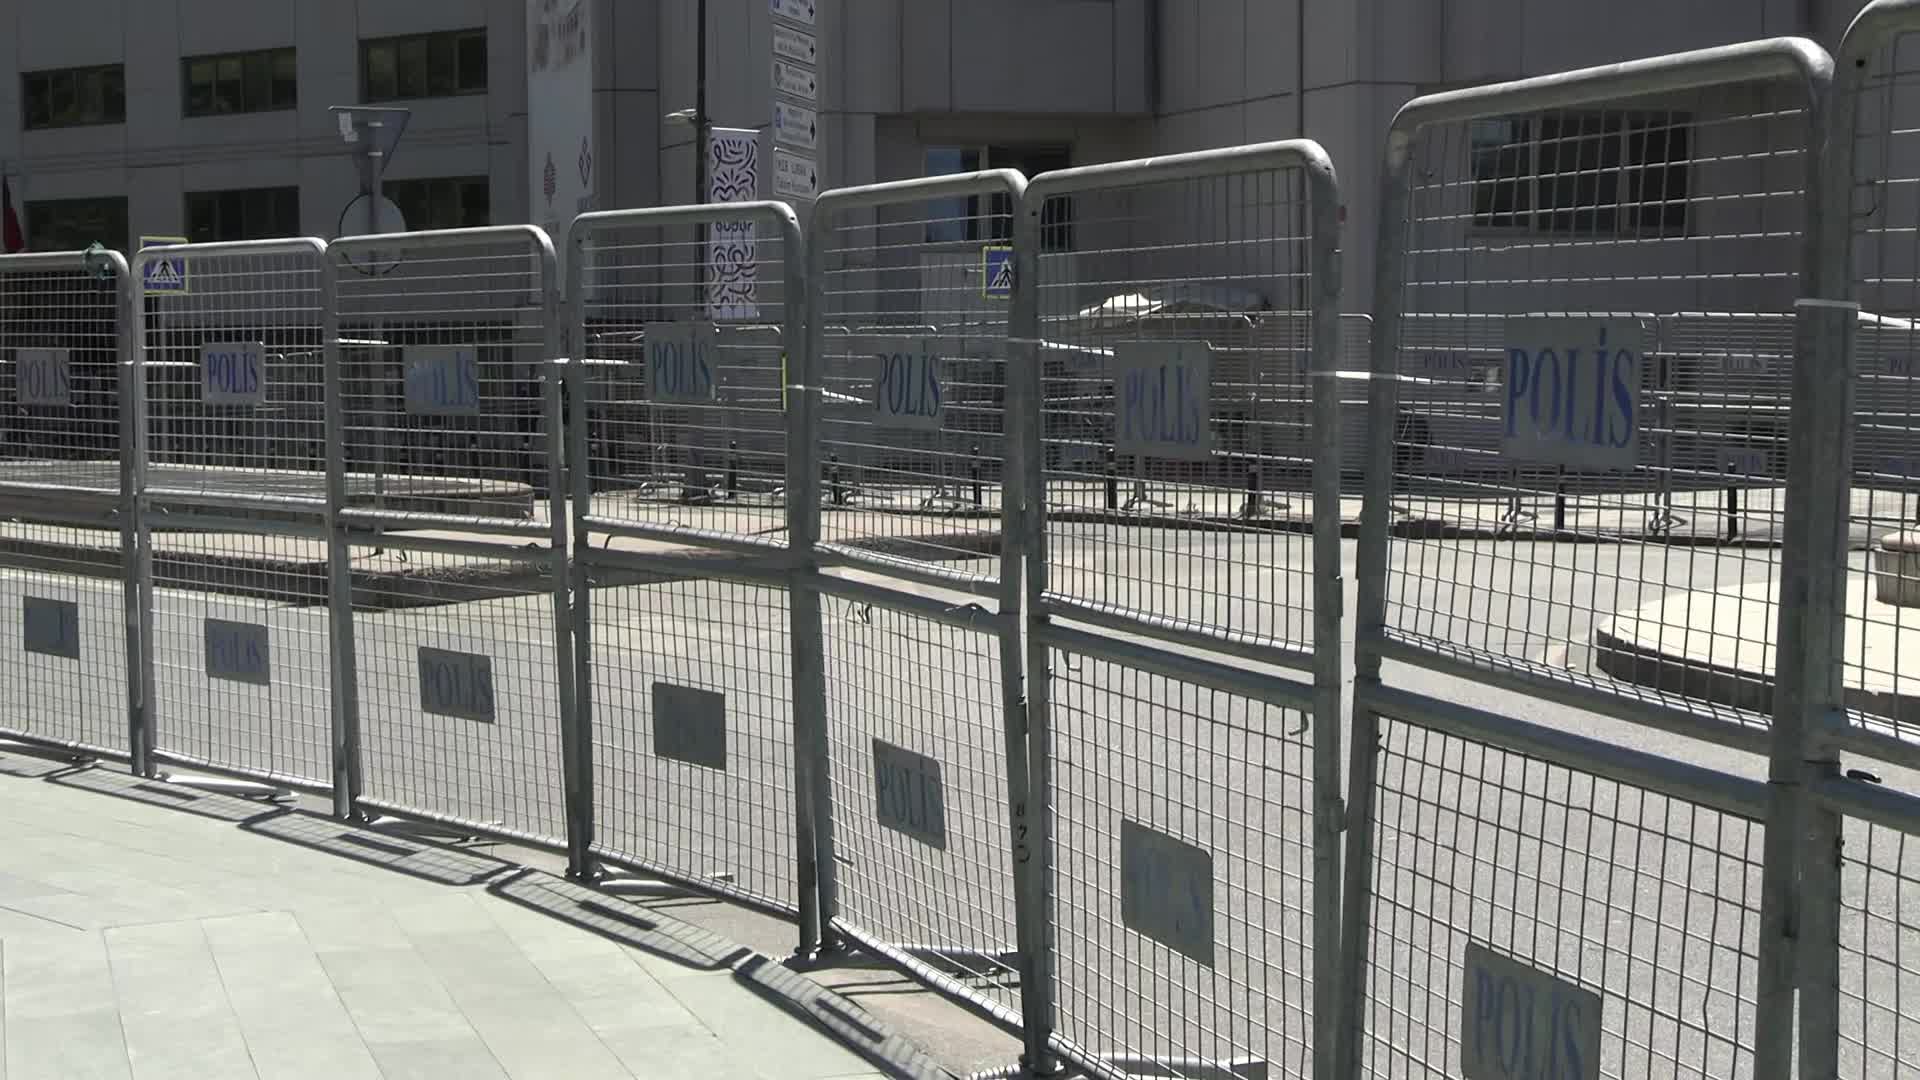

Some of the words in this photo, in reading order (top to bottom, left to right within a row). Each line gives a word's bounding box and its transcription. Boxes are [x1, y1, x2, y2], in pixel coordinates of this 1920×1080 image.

[18, 353, 70, 400] POLİS
[208, 344, 258, 393] POLİS
[409, 351, 480, 408] LİS
[652, 328, 712, 396] POLİS
[877, 338, 940, 417] POLİS
[1505, 326, 1633, 449] POLİS
